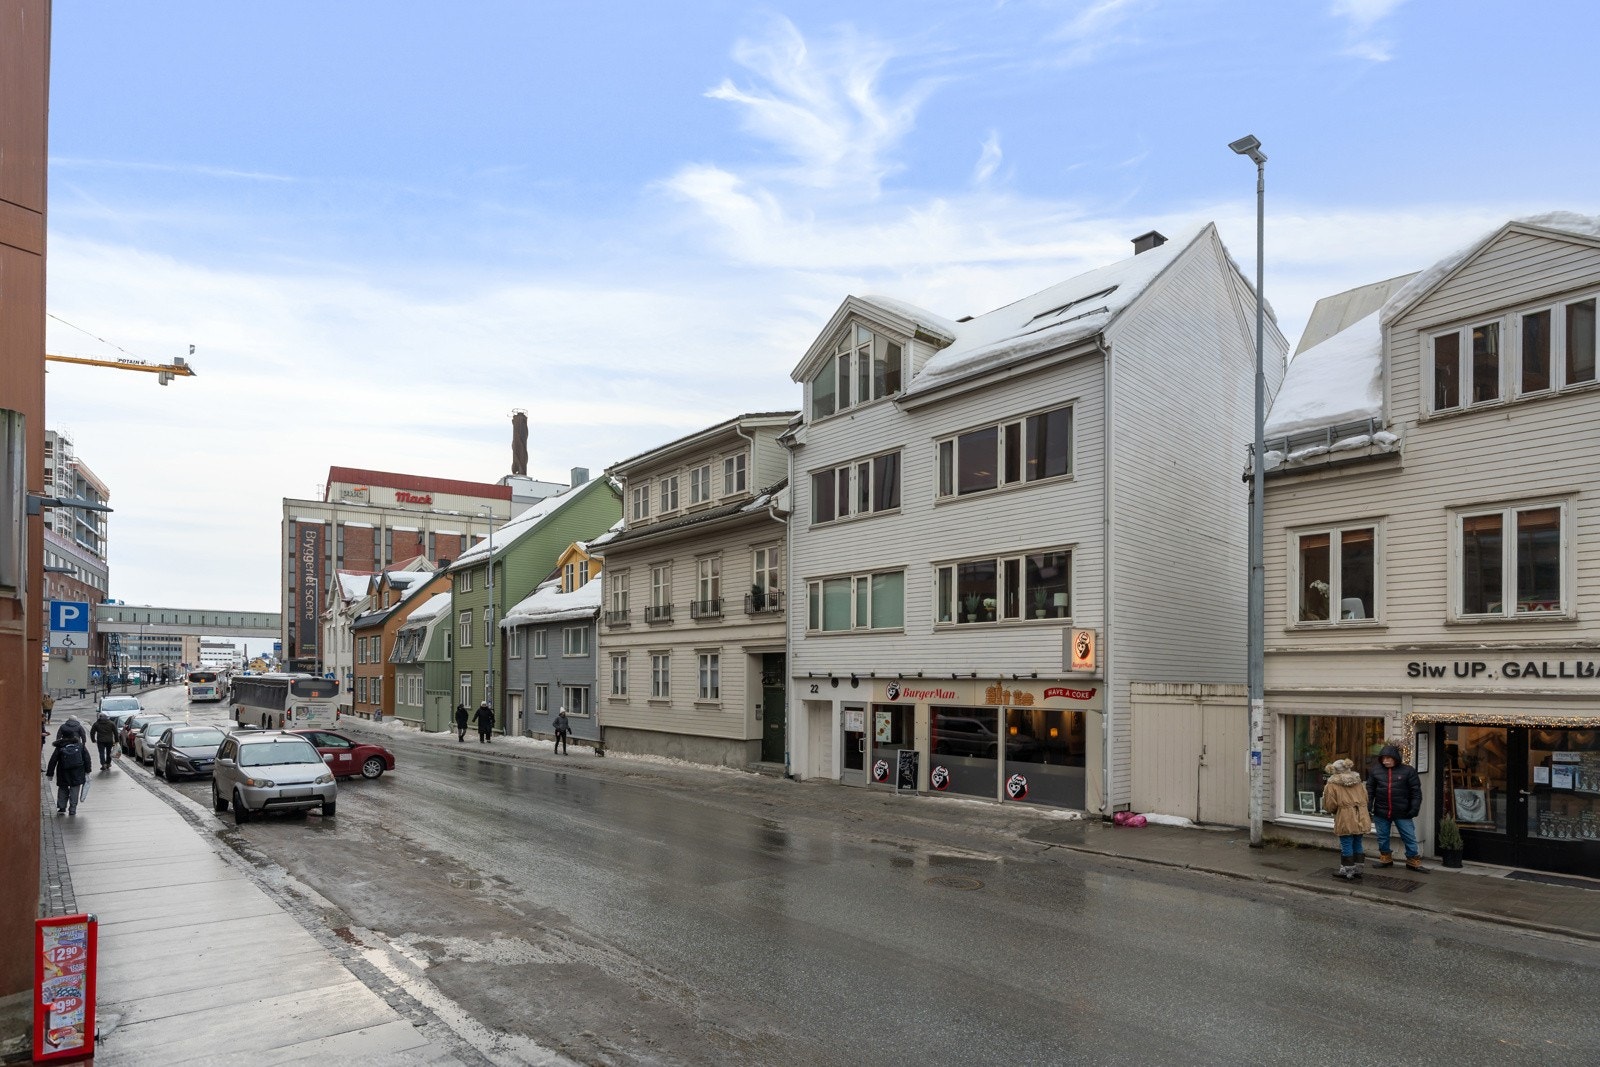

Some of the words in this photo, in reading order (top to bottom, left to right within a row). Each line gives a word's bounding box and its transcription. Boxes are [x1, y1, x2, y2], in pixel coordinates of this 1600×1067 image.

[395, 491, 433, 505] Mack
[303, 530, 317, 587] Bryggeriet
[305, 591, 315, 620] scene
[60, 605, 80, 628] P
[1407, 662, 1446, 678] Siw
[810, 684, 819, 693] 22
[903, 688, 955, 700] BurgerMan
